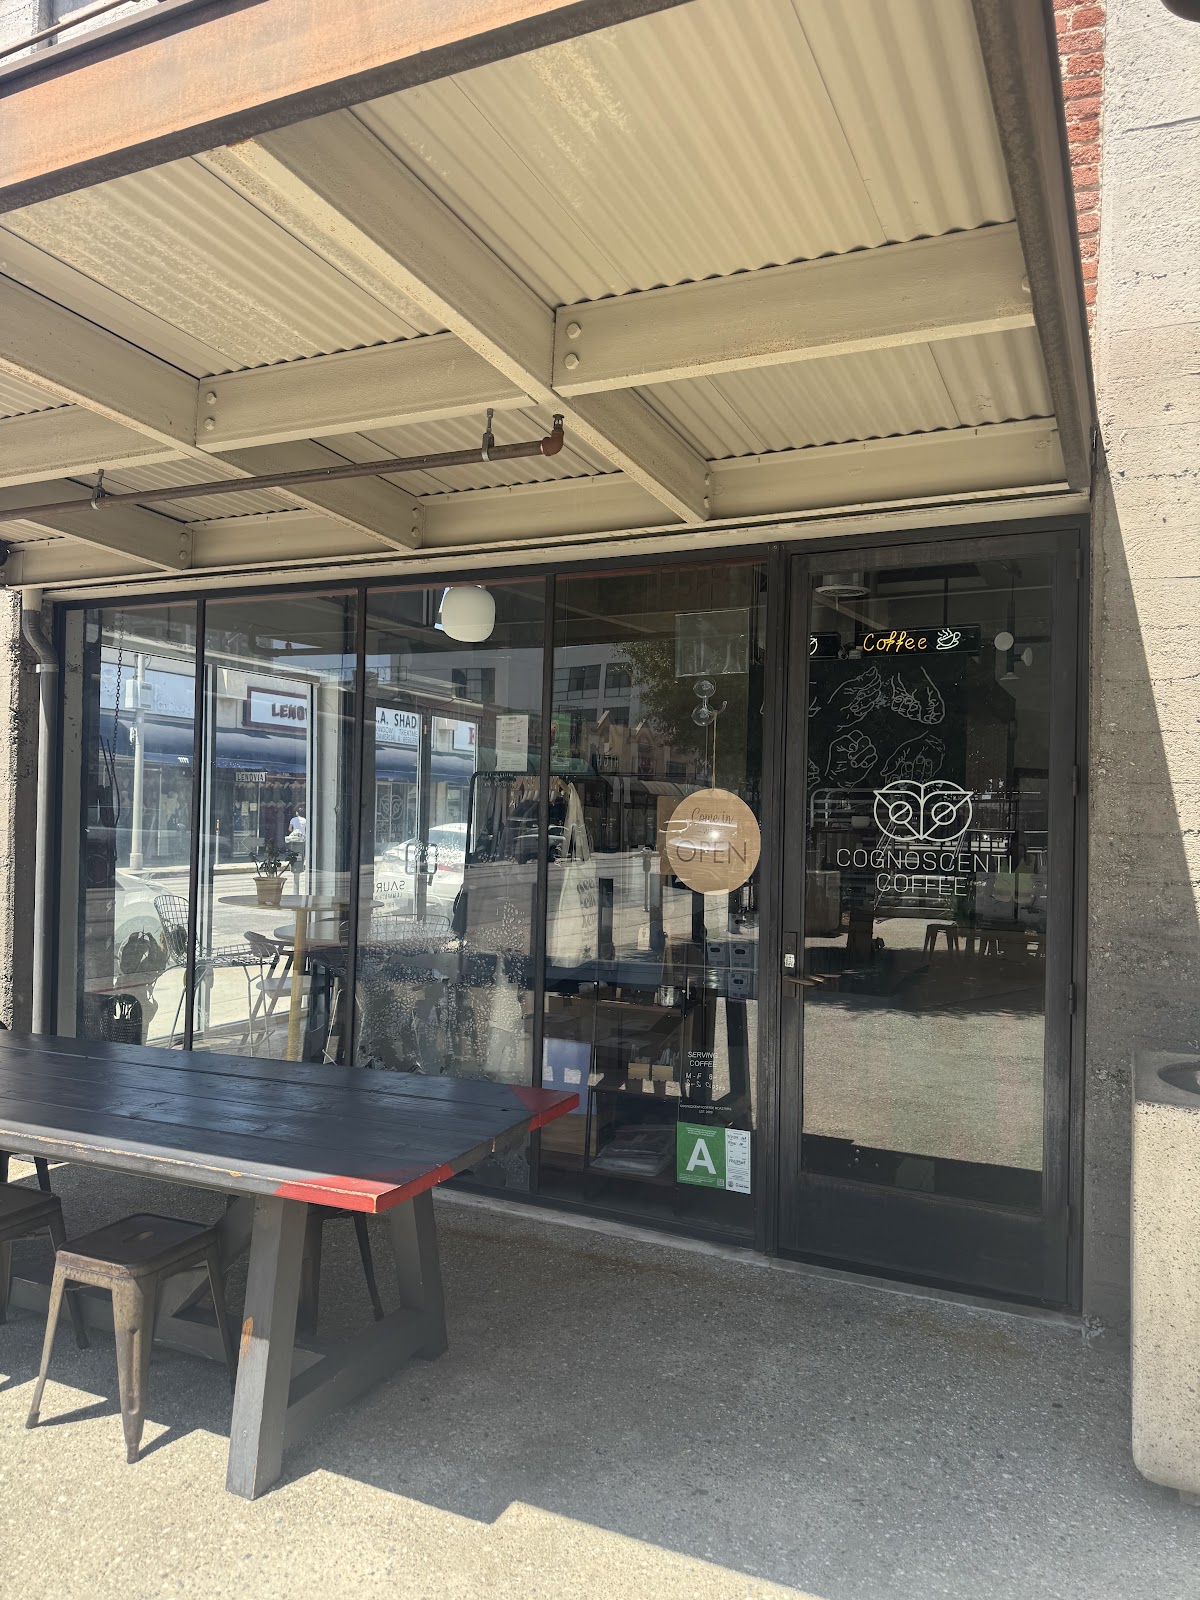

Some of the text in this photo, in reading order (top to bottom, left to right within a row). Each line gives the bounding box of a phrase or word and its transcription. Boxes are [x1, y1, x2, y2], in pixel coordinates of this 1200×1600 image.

[863, 630, 928, 653] Coffee
[272, 702, 307, 721] LENO
[394, 713, 417, 729] SHAD
[236, 773, 264, 781] LENOVIA
[691, 807, 734, 824] Come in
[676, 839, 747, 865] OPEN
[836, 848, 1012, 874] COGNOSCENTI
[876, 873, 968, 897] COFFEE
[687, 1051, 718, 1059] SERVING
[689, 1060, 718, 1068] COFFEE
[686, 1138, 717, 1175] A
